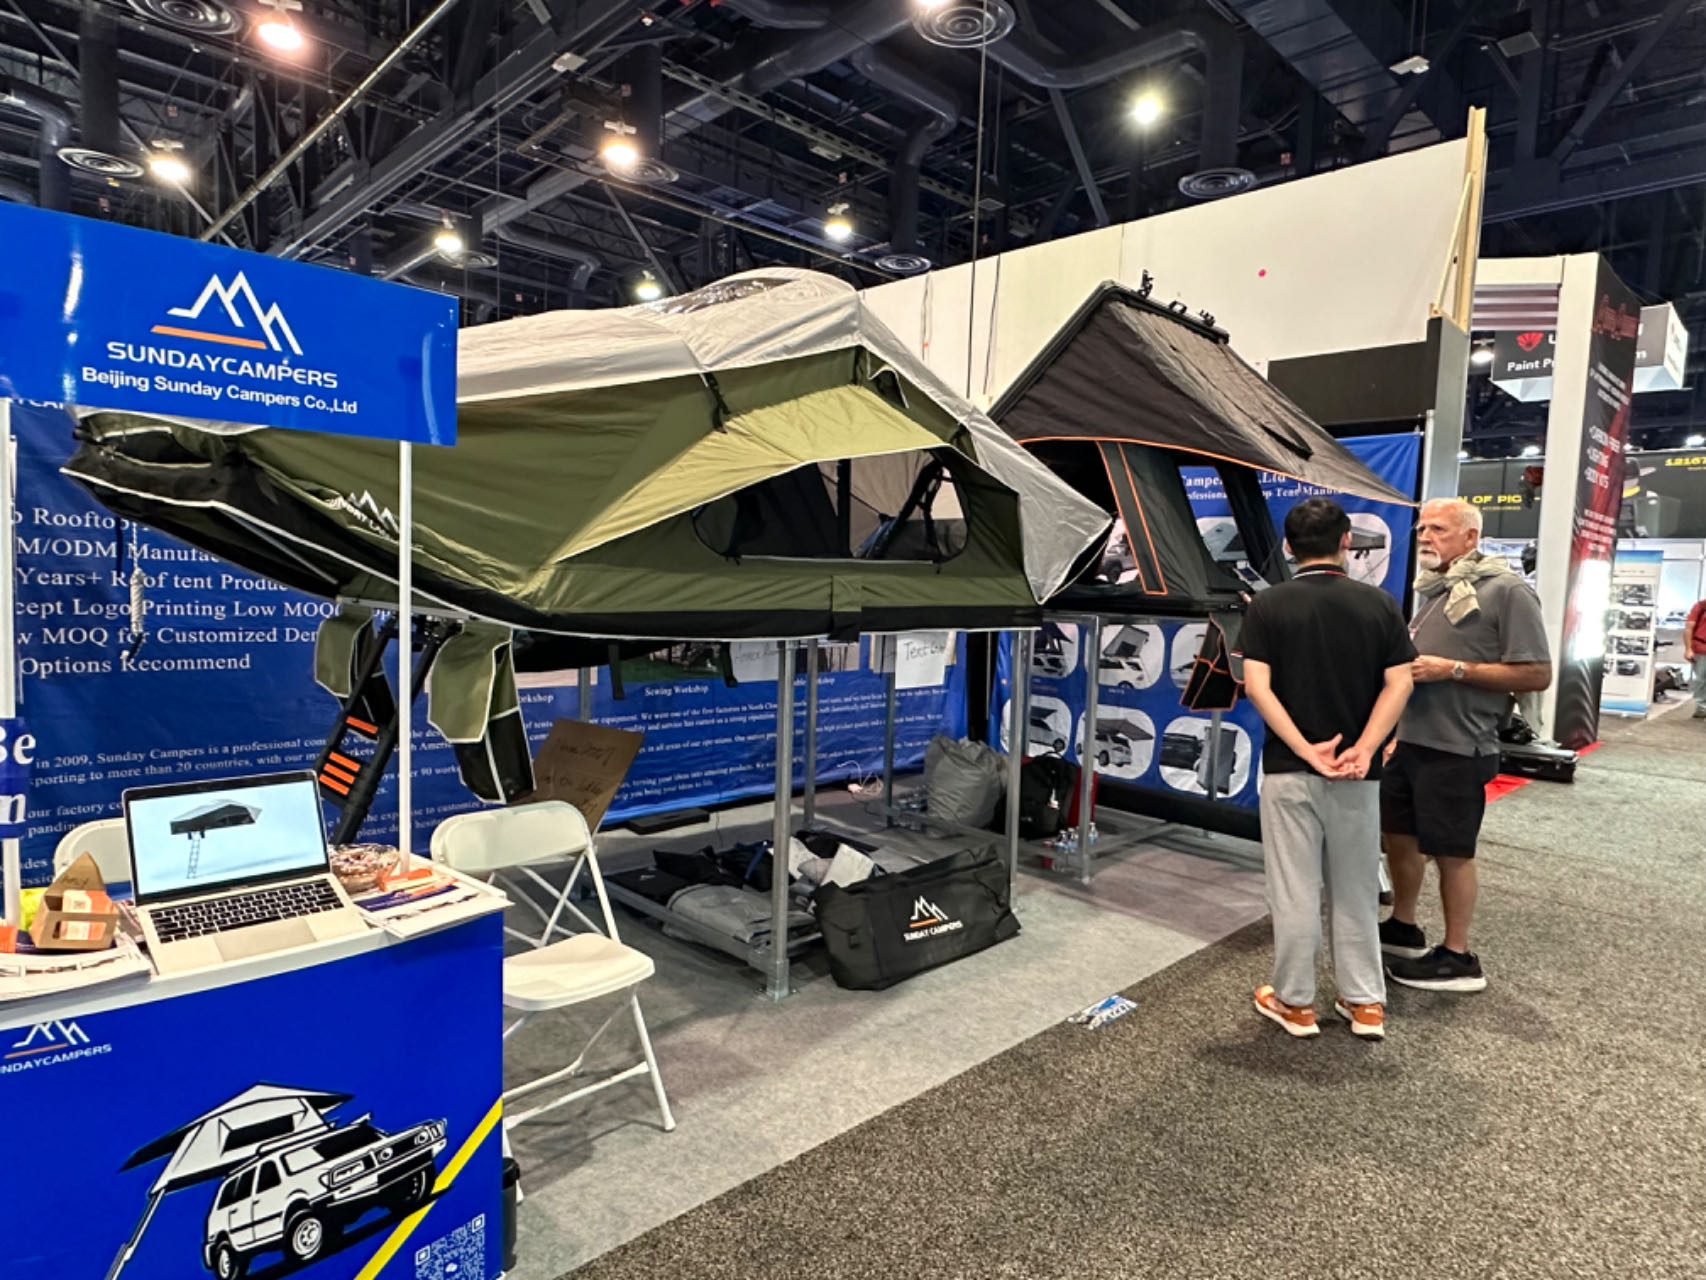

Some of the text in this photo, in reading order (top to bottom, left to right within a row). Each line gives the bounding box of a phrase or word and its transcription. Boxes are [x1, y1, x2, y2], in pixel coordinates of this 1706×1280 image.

[106, 341, 338, 389] SUNDAYCAMPERS
[1507, 358, 1540, 372] Paint
[82, 367, 357, 414] Beijing Sunday Campers Co.,Ltd
[1472, 495, 1493, 504] OF
[16, 566, 103, 585] Years+
[110, 570, 168, 588] Rof
[173, 574, 213, 589] tent
[72, 598, 132, 620] Logo
[142, 599, 226, 620] Printing
[233, 600, 276, 616] Low
[42, 627, 109, 647] MOQ
[157, 627, 278, 644] Customized
[20, 653, 251, 679] Options Recommend
[53, 754, 94, 768] 2009,
[97, 751, 145, 764] Sunday
[150, 747, 205, 759] Campers
[232, 738, 301, 754] professional
[107, 767, 140, 779] more
[56, 803, 104, 817] factory
[0, 1043, 113, 1075] NDAYCAMPERS
